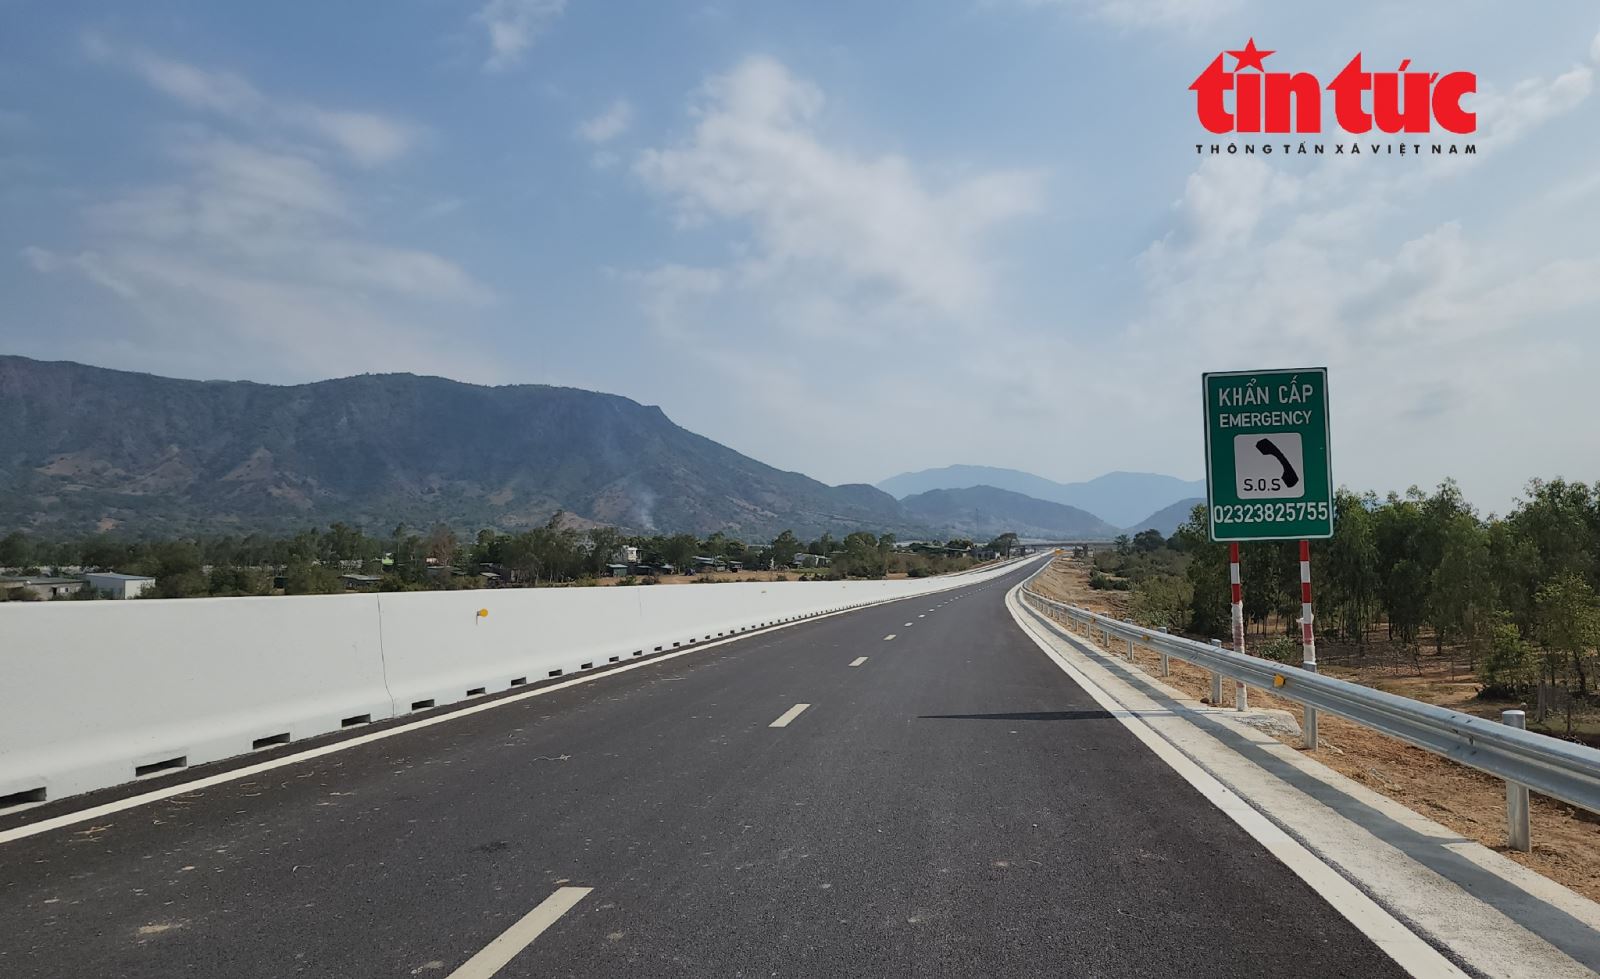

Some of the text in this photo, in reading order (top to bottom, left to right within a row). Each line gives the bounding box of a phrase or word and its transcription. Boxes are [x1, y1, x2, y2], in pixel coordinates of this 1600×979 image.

[1218, 375, 1313, 406] KHẨN CẤP
[1219, 411, 1312, 428] EMERGENCY
[1243, 478, 1281, 492] S.O.S
[1214, 503, 1328, 524] 02323825755
